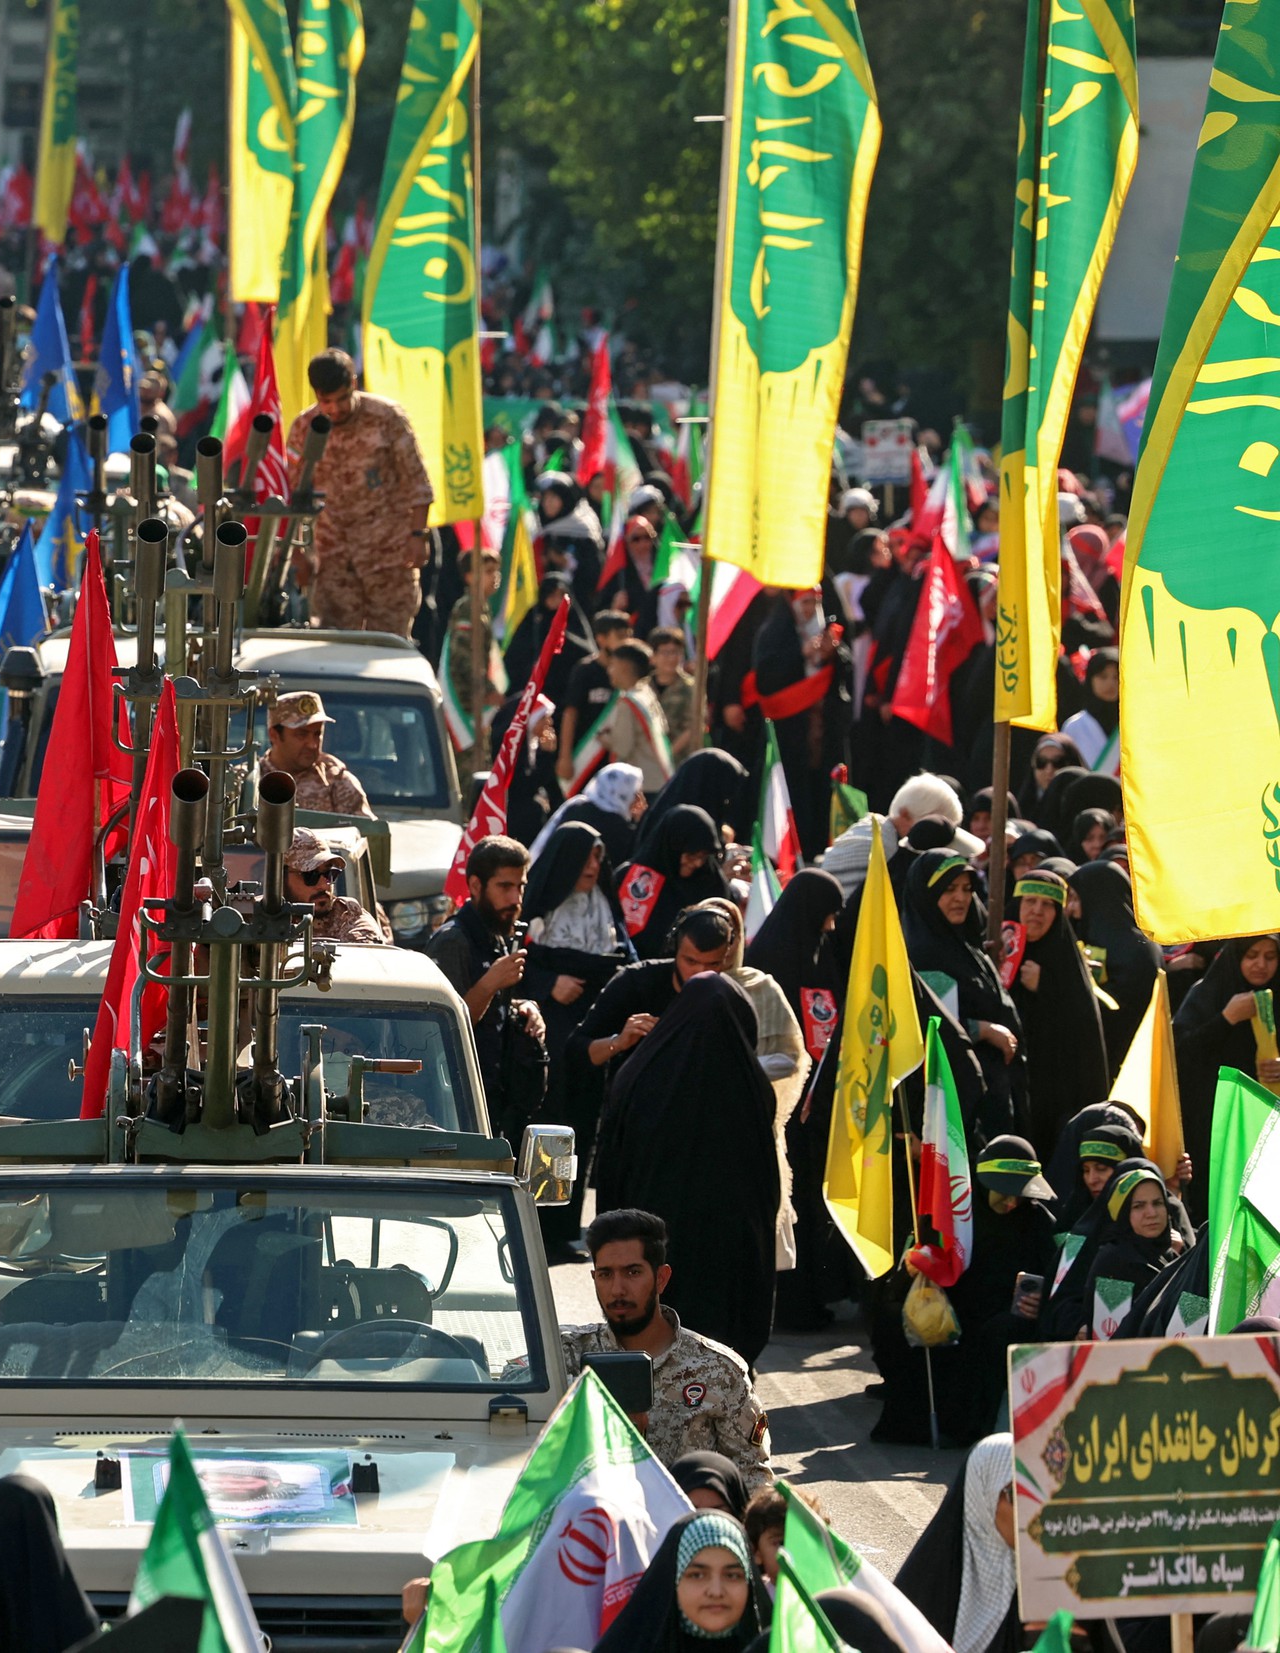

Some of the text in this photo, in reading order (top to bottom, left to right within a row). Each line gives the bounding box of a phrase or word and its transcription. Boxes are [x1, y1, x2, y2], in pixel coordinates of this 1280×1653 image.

[1073, 1413, 1128, 1483] ایران
[1131, 1409, 1217, 1480] جانفدای
[1119, 1552, 1245, 1597] سپاه مالک اشتر
